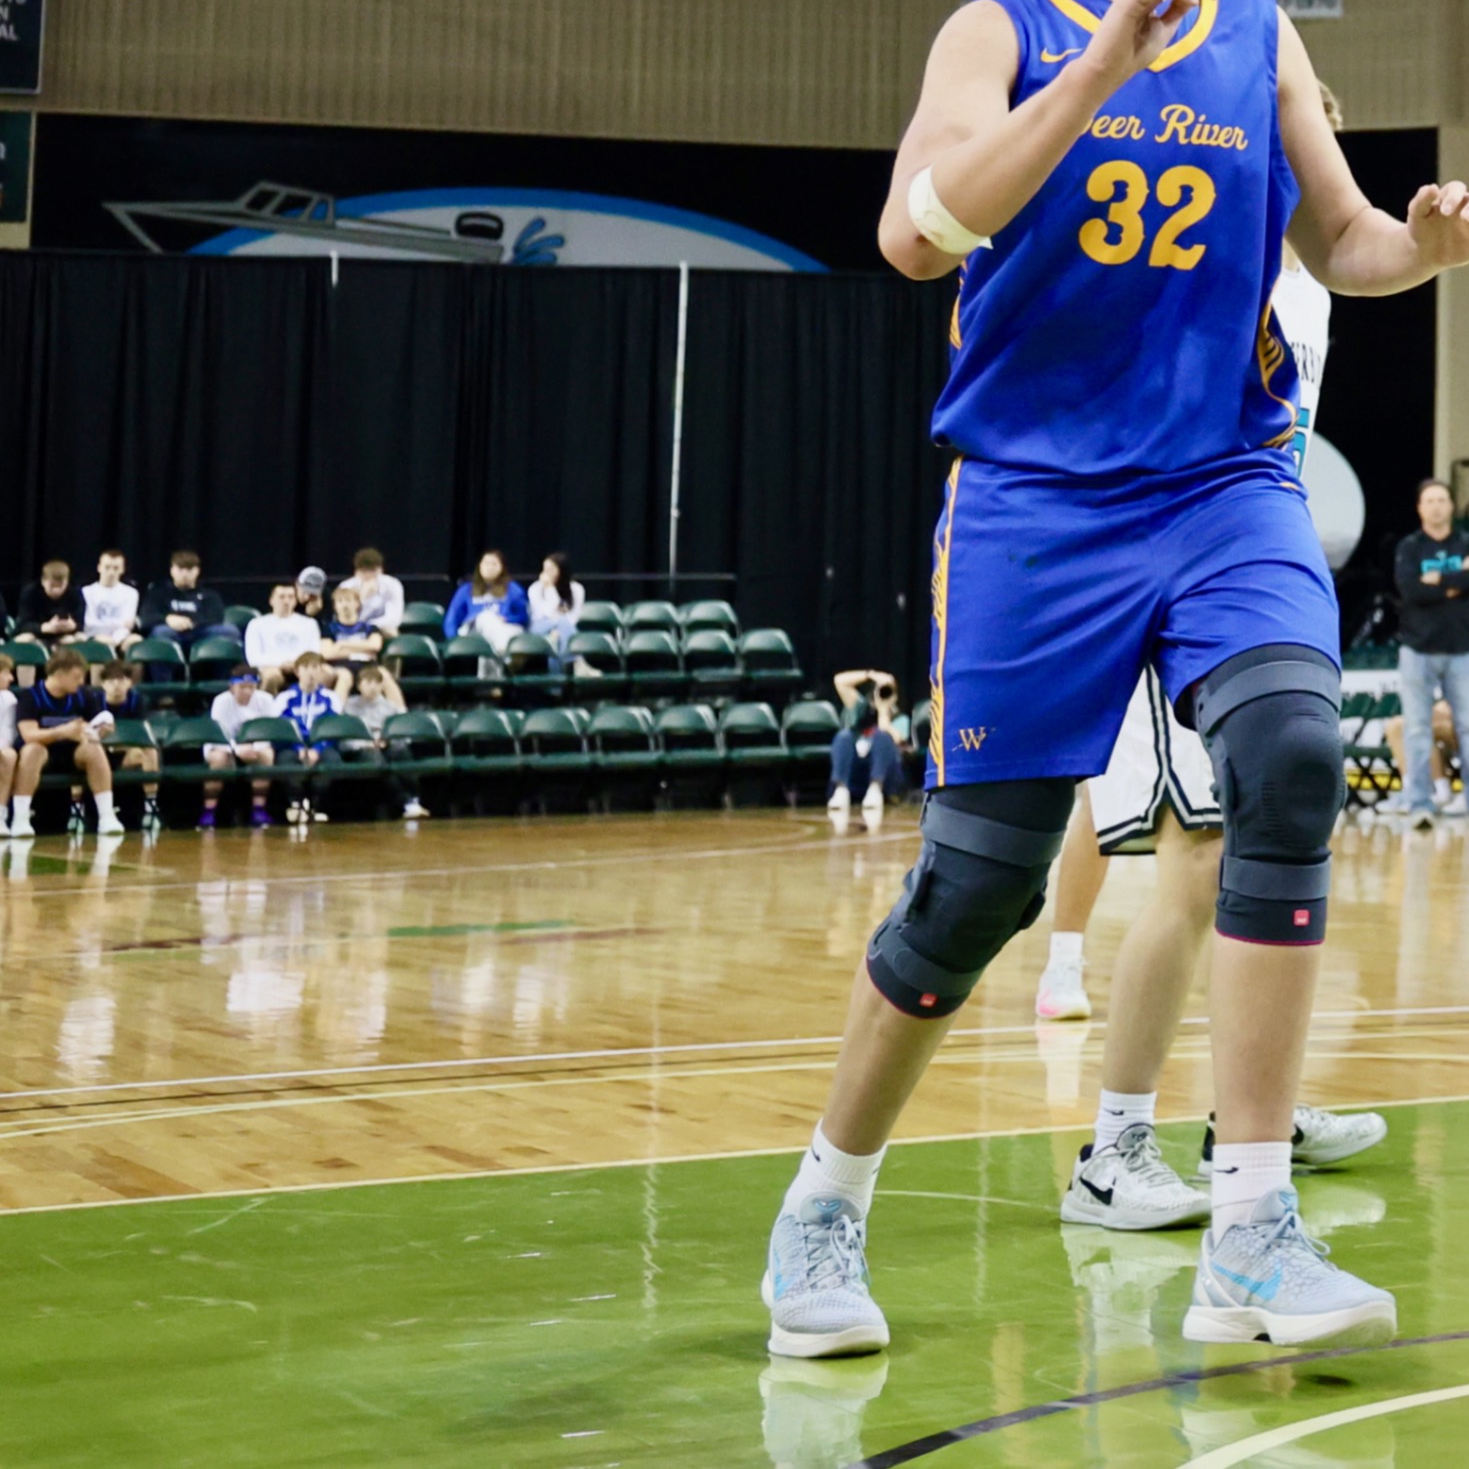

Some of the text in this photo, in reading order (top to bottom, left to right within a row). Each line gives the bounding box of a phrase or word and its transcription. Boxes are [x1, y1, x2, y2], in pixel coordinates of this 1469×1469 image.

[1081, 104, 1248, 151] eer River
[1079, 160, 1216, 270] 32
